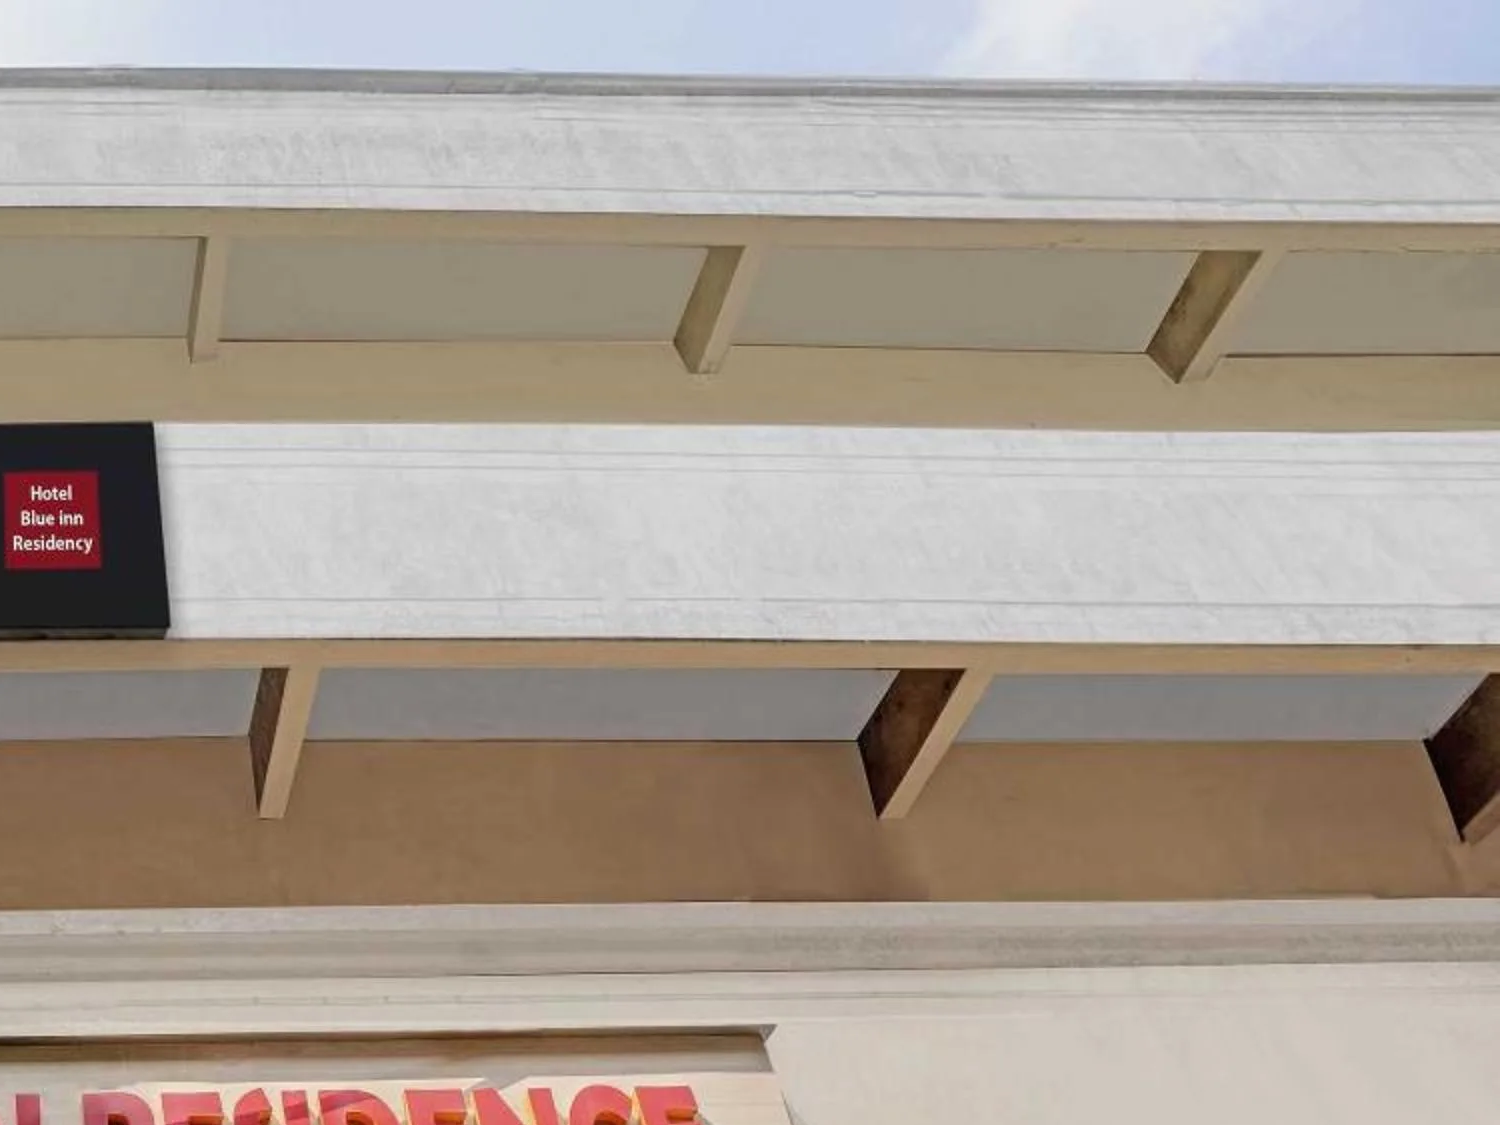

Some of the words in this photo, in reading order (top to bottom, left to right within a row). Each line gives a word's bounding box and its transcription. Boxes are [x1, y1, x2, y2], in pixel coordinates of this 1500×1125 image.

[30, 485, 73, 501] Hotel
[20, 509, 55, 526] Blue
[59, 509, 84, 525] inn
[13, 534, 93, 554] Residency
